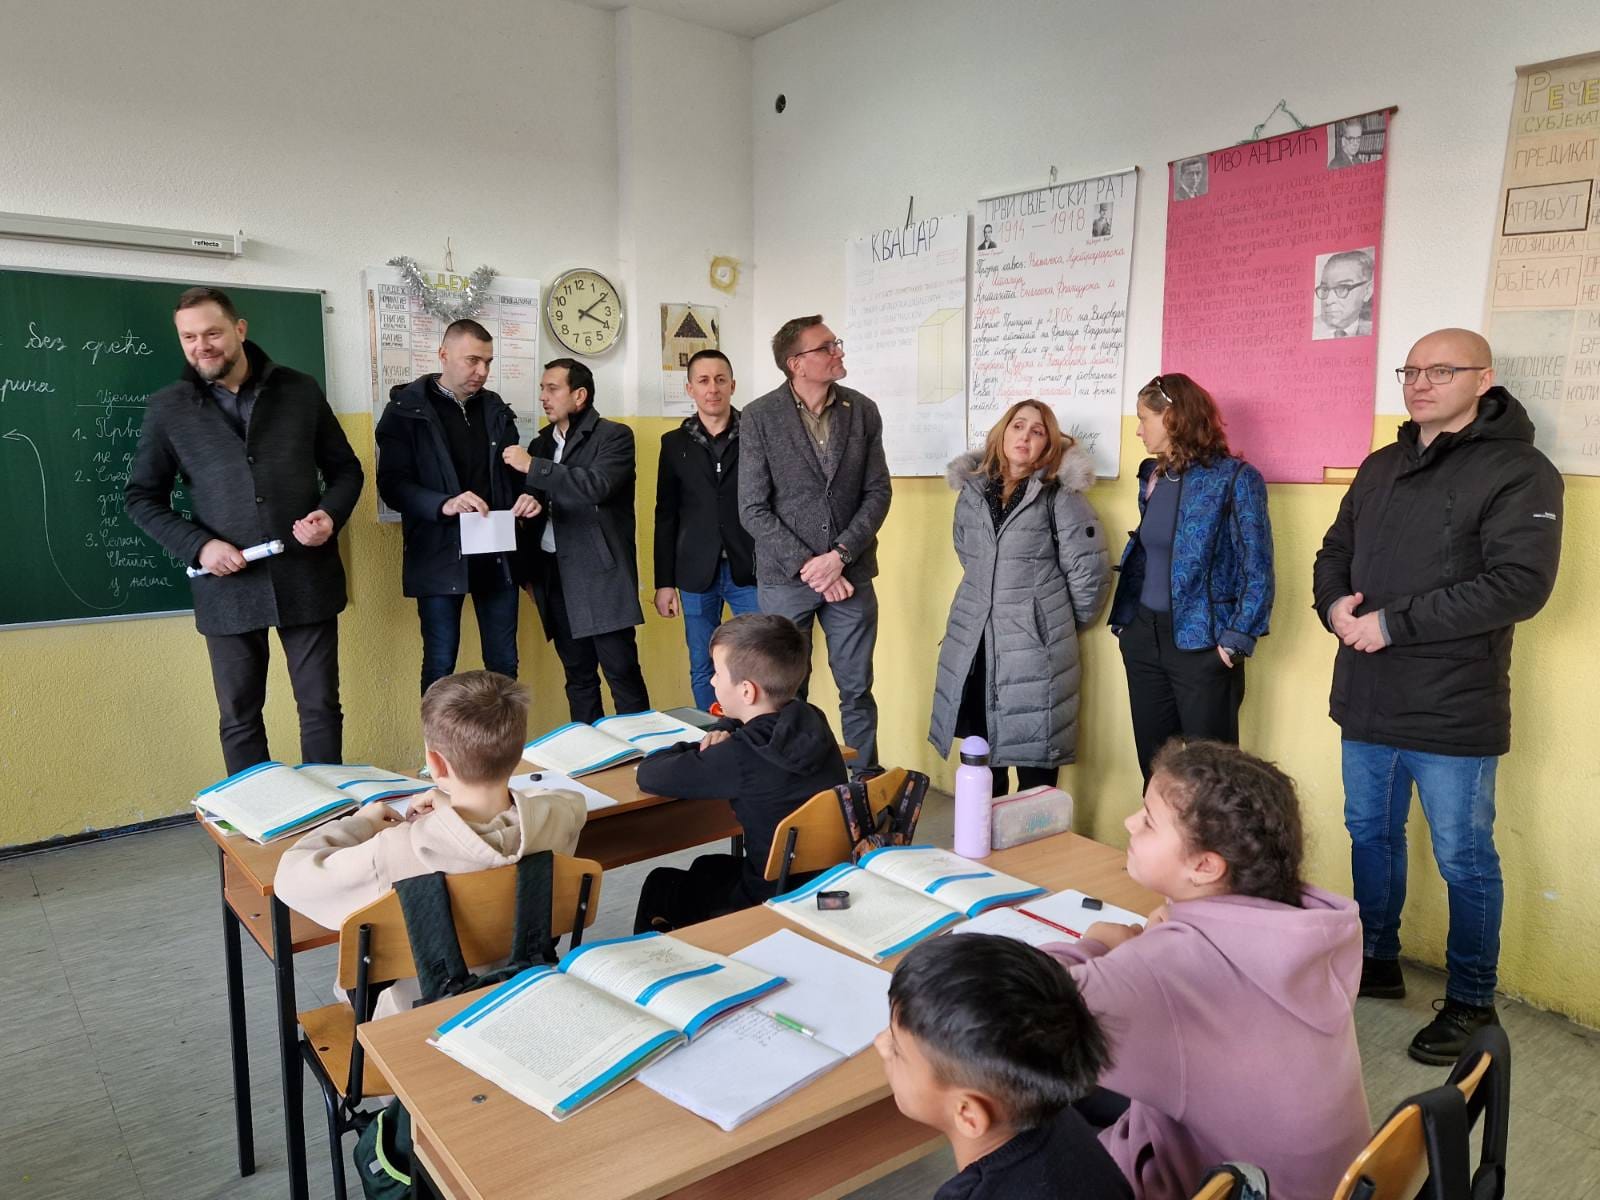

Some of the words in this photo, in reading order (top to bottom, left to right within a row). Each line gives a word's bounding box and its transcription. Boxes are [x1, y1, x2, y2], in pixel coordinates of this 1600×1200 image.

[1524, 110, 1600, 133] СУБЈЕКАТ
[1213, 150, 1242, 174] ИВО
[1248, 135, 1318, 167] АНДРИЋ
[1514, 138, 1599, 169] ПРЕДИКАТ
[1096, 176, 1125, 202] РАТ
[1506, 194, 1584, 223] АТРИБУТ
[1049, 208, 1085, 234] 1918
[872, 217, 939, 263] КВАДАР
[1500, 235, 1576, 255] АПОЗИЦИЈА
[574, 279, 585, 291] 12
[1496, 265, 1578, 292] ОБЈЕКАТ
[563, 284, 573, 295] 11
[591, 282, 596, 293] 1
[553, 295, 567, 307] 10
[555, 310, 564, 321] 9
[604, 305, 612, 317] 3
[561, 324, 570, 335] 8
[595, 330, 604, 341] 5
[572, 332, 580, 344] 7
[584, 335, 593, 347] 6
[72, 428, 87, 441] 1.
[74, 469, 92, 482] 2.
[85, 532, 99, 548] 3.
